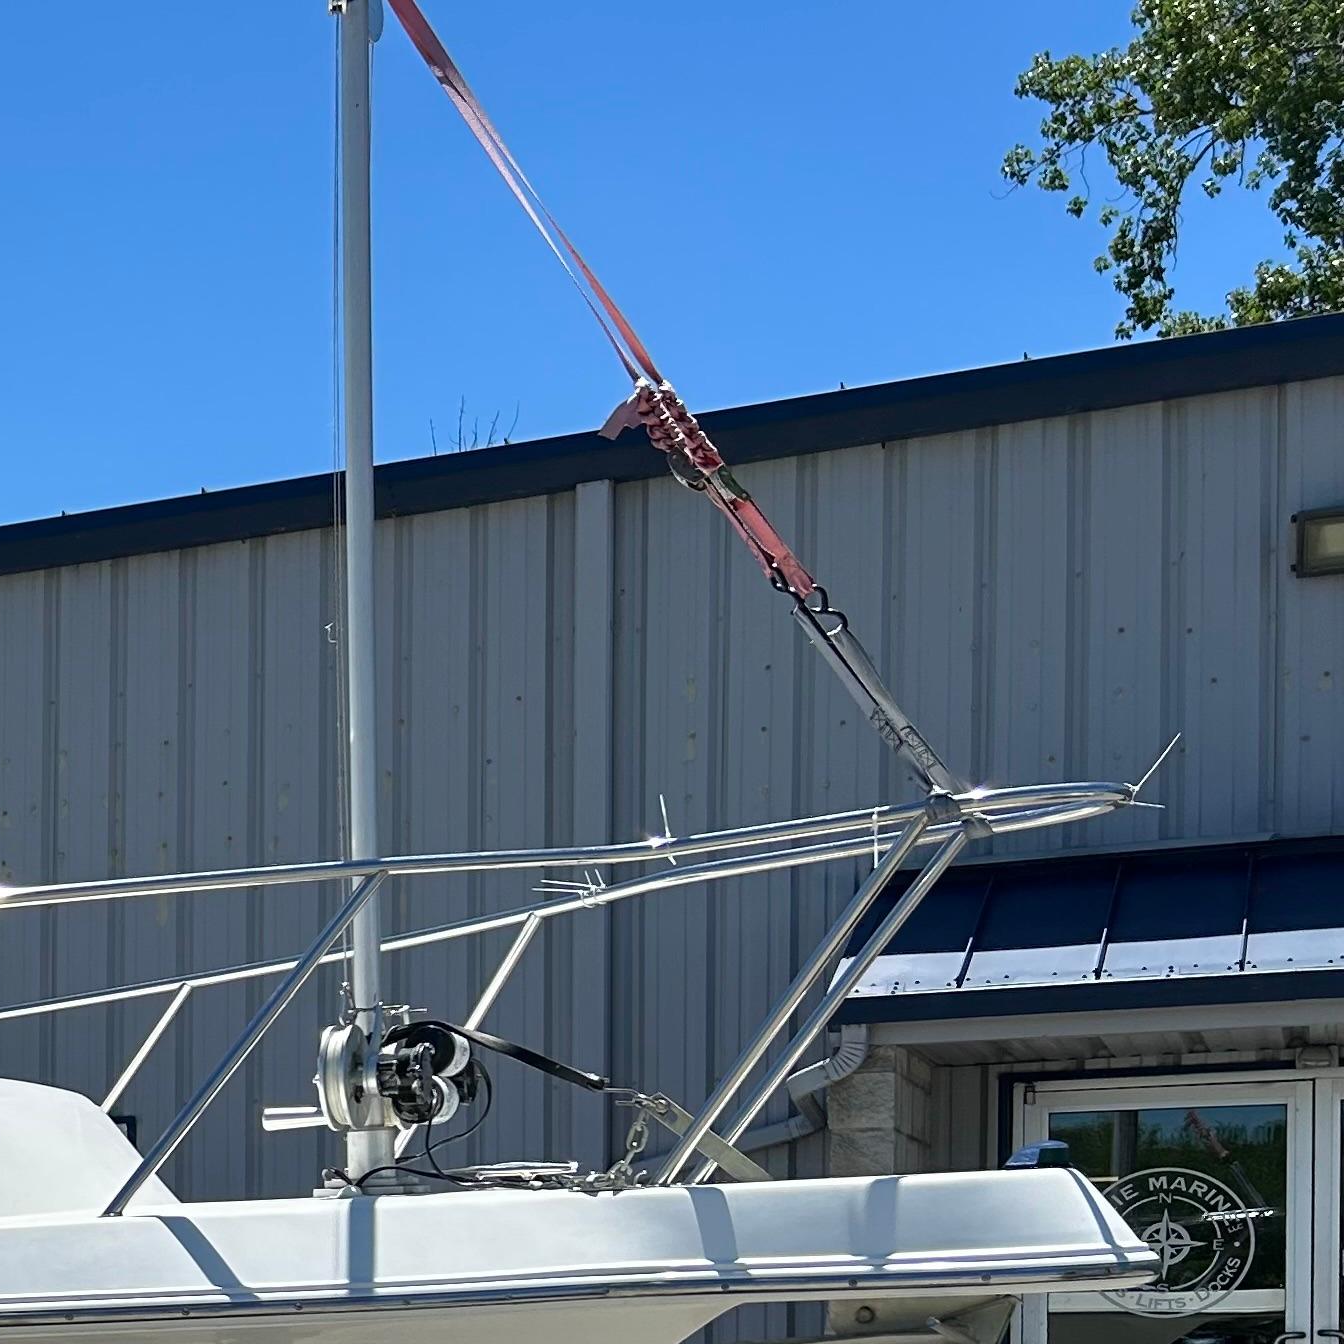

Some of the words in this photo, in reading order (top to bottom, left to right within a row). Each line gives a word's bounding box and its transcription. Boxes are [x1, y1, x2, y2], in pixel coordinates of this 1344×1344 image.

[1111, 1183, 1139, 1206] IE
[1158, 1192, 1172, 1204] N
[1212, 1239, 1225, 1251] E
[1193, 1256, 1241, 1303] DOCKS
